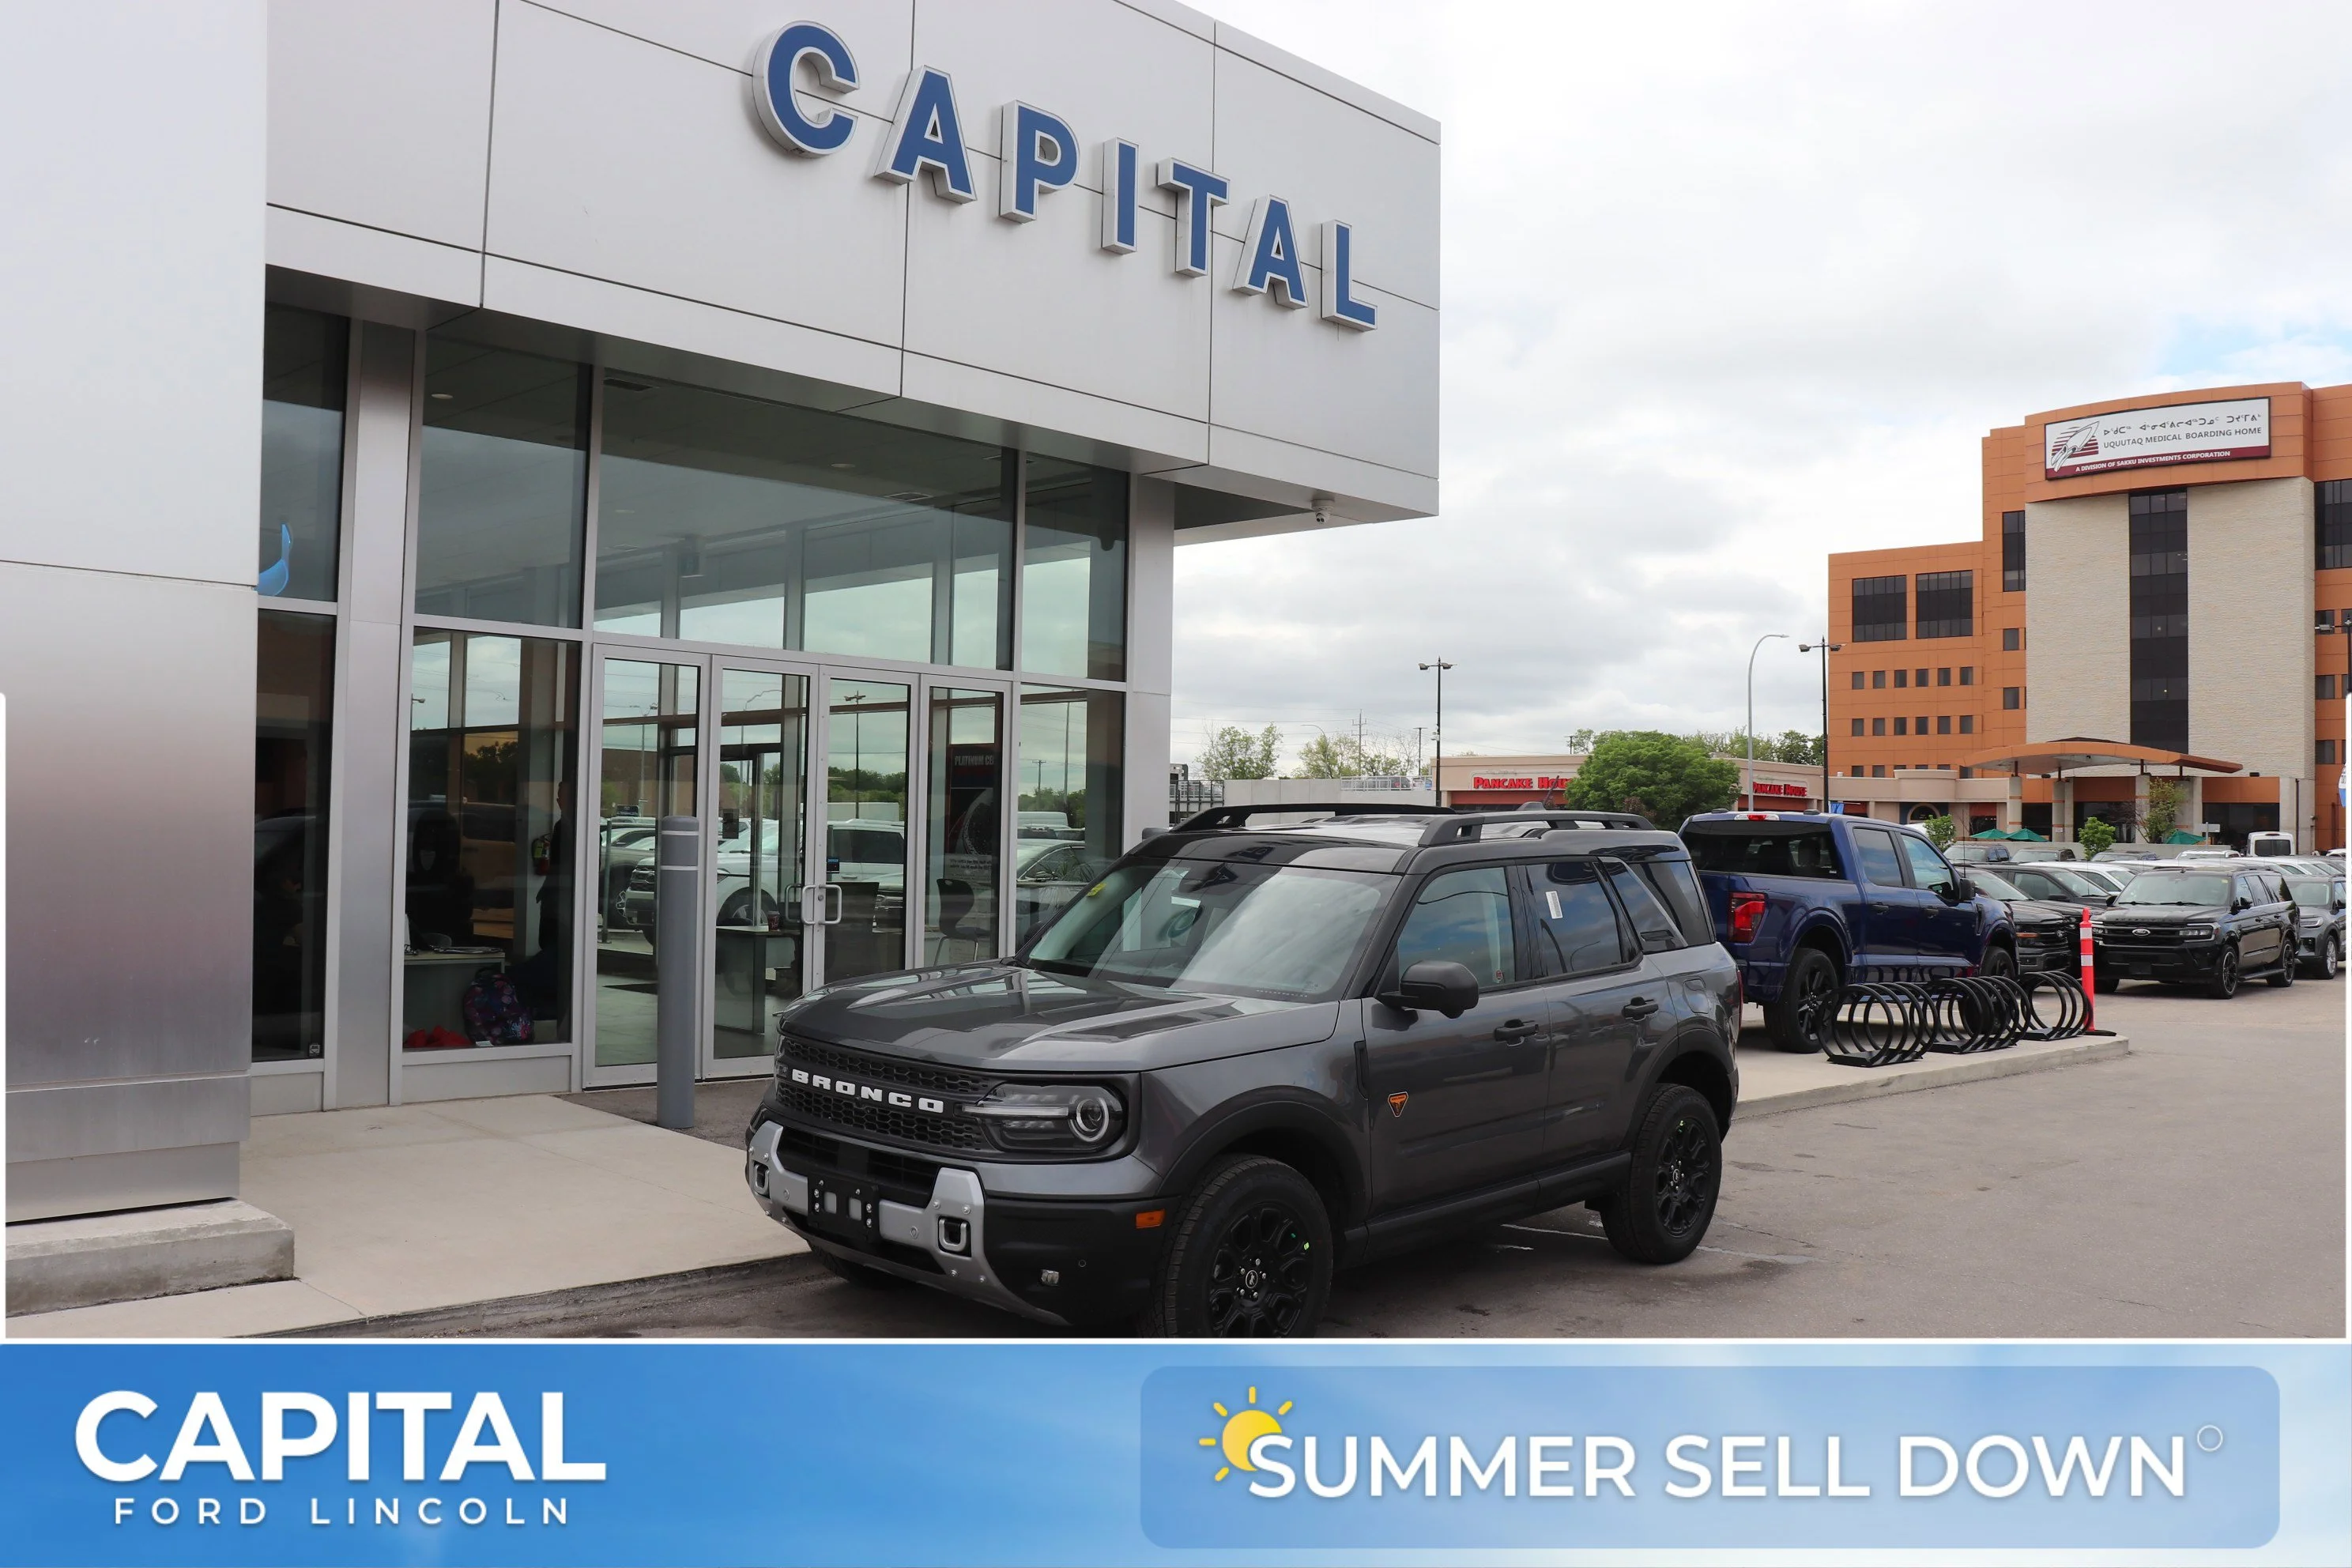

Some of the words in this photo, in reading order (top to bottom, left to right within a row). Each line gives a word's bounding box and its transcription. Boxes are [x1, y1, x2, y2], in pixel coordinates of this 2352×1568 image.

[752, 20, 1378, 332] CAPITAL
[2103, 437, 2143, 449] UQUUTAQ
[2145, 434, 2182, 443] MEDICAL
[2185, 429, 2232, 439] BOARDING
[2138, 454, 2181, 464] INVESTMENTS
[2182, 450, 2231, 460] CORPORATION
[1473, 777, 1533, 789] PANCAKE
[792, 1069, 944, 1114] BRONCO
